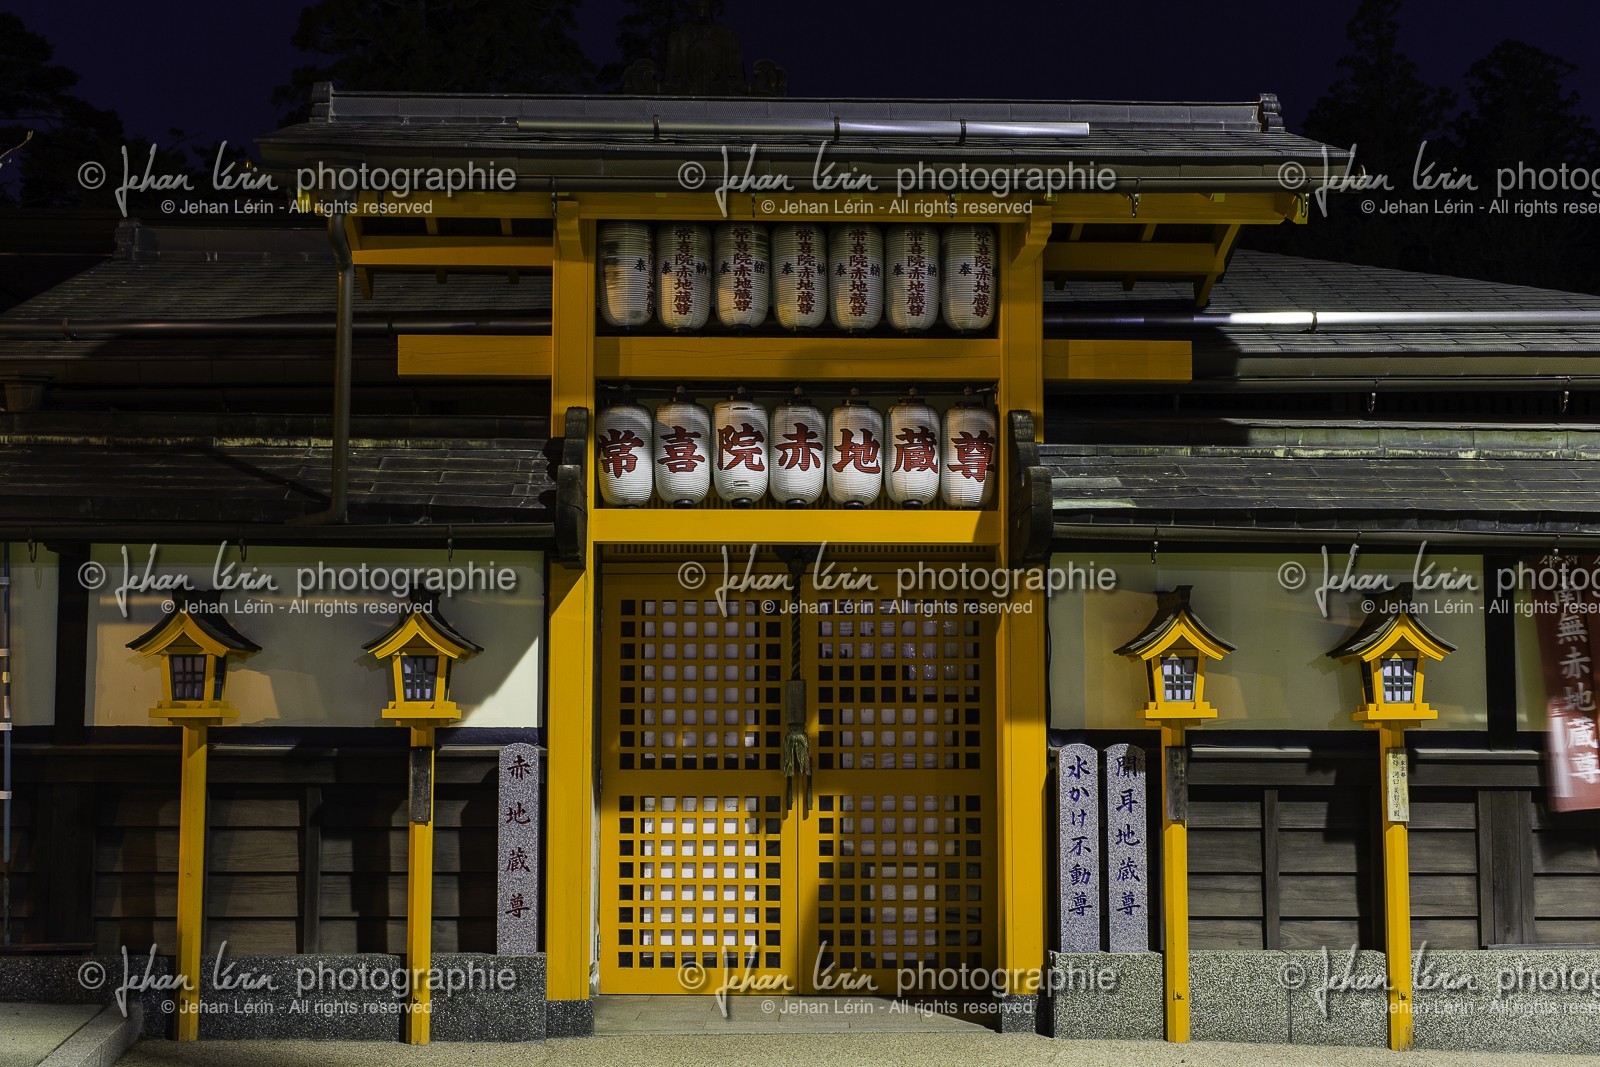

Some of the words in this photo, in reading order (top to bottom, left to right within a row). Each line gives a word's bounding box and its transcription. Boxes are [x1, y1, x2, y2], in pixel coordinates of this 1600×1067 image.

[505, 755, 530, 918] 赤地蔵尊
[1068, 755, 1092, 916] 水かけ不動尊
